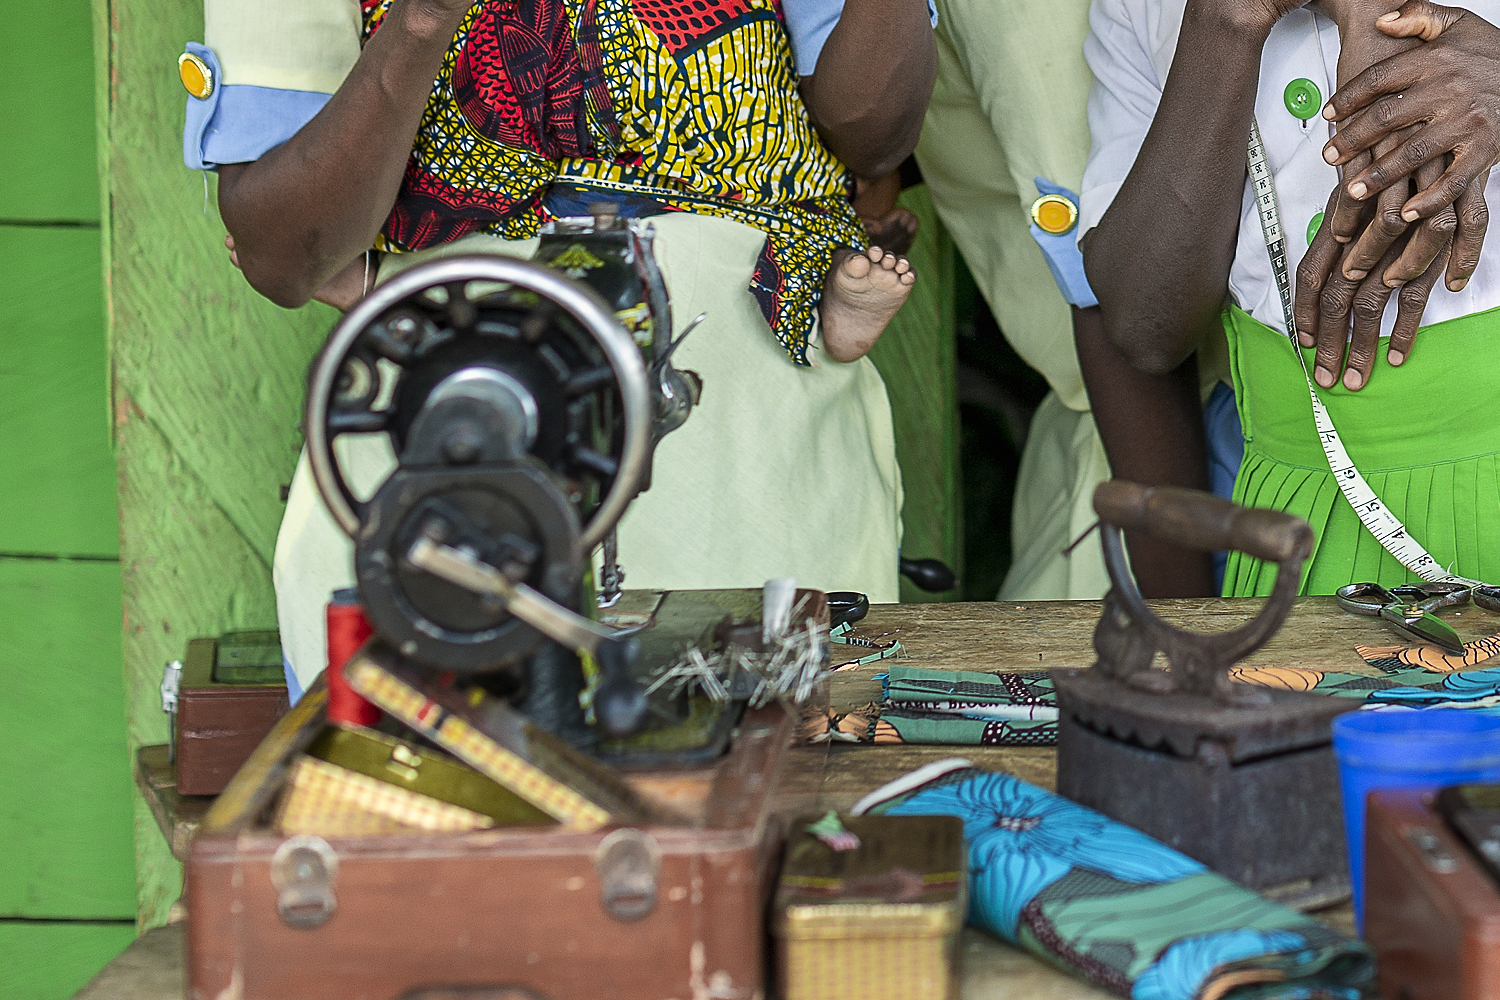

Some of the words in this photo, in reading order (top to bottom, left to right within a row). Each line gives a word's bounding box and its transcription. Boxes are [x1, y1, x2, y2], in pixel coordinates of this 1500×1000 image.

[1326, 433, 1336, 443] 7
[1343, 469, 1356, 480] 6
[1365, 501, 1380, 513] 5
[1391, 530, 1405, 539] 4
[1418, 556, 1433, 567] 3
